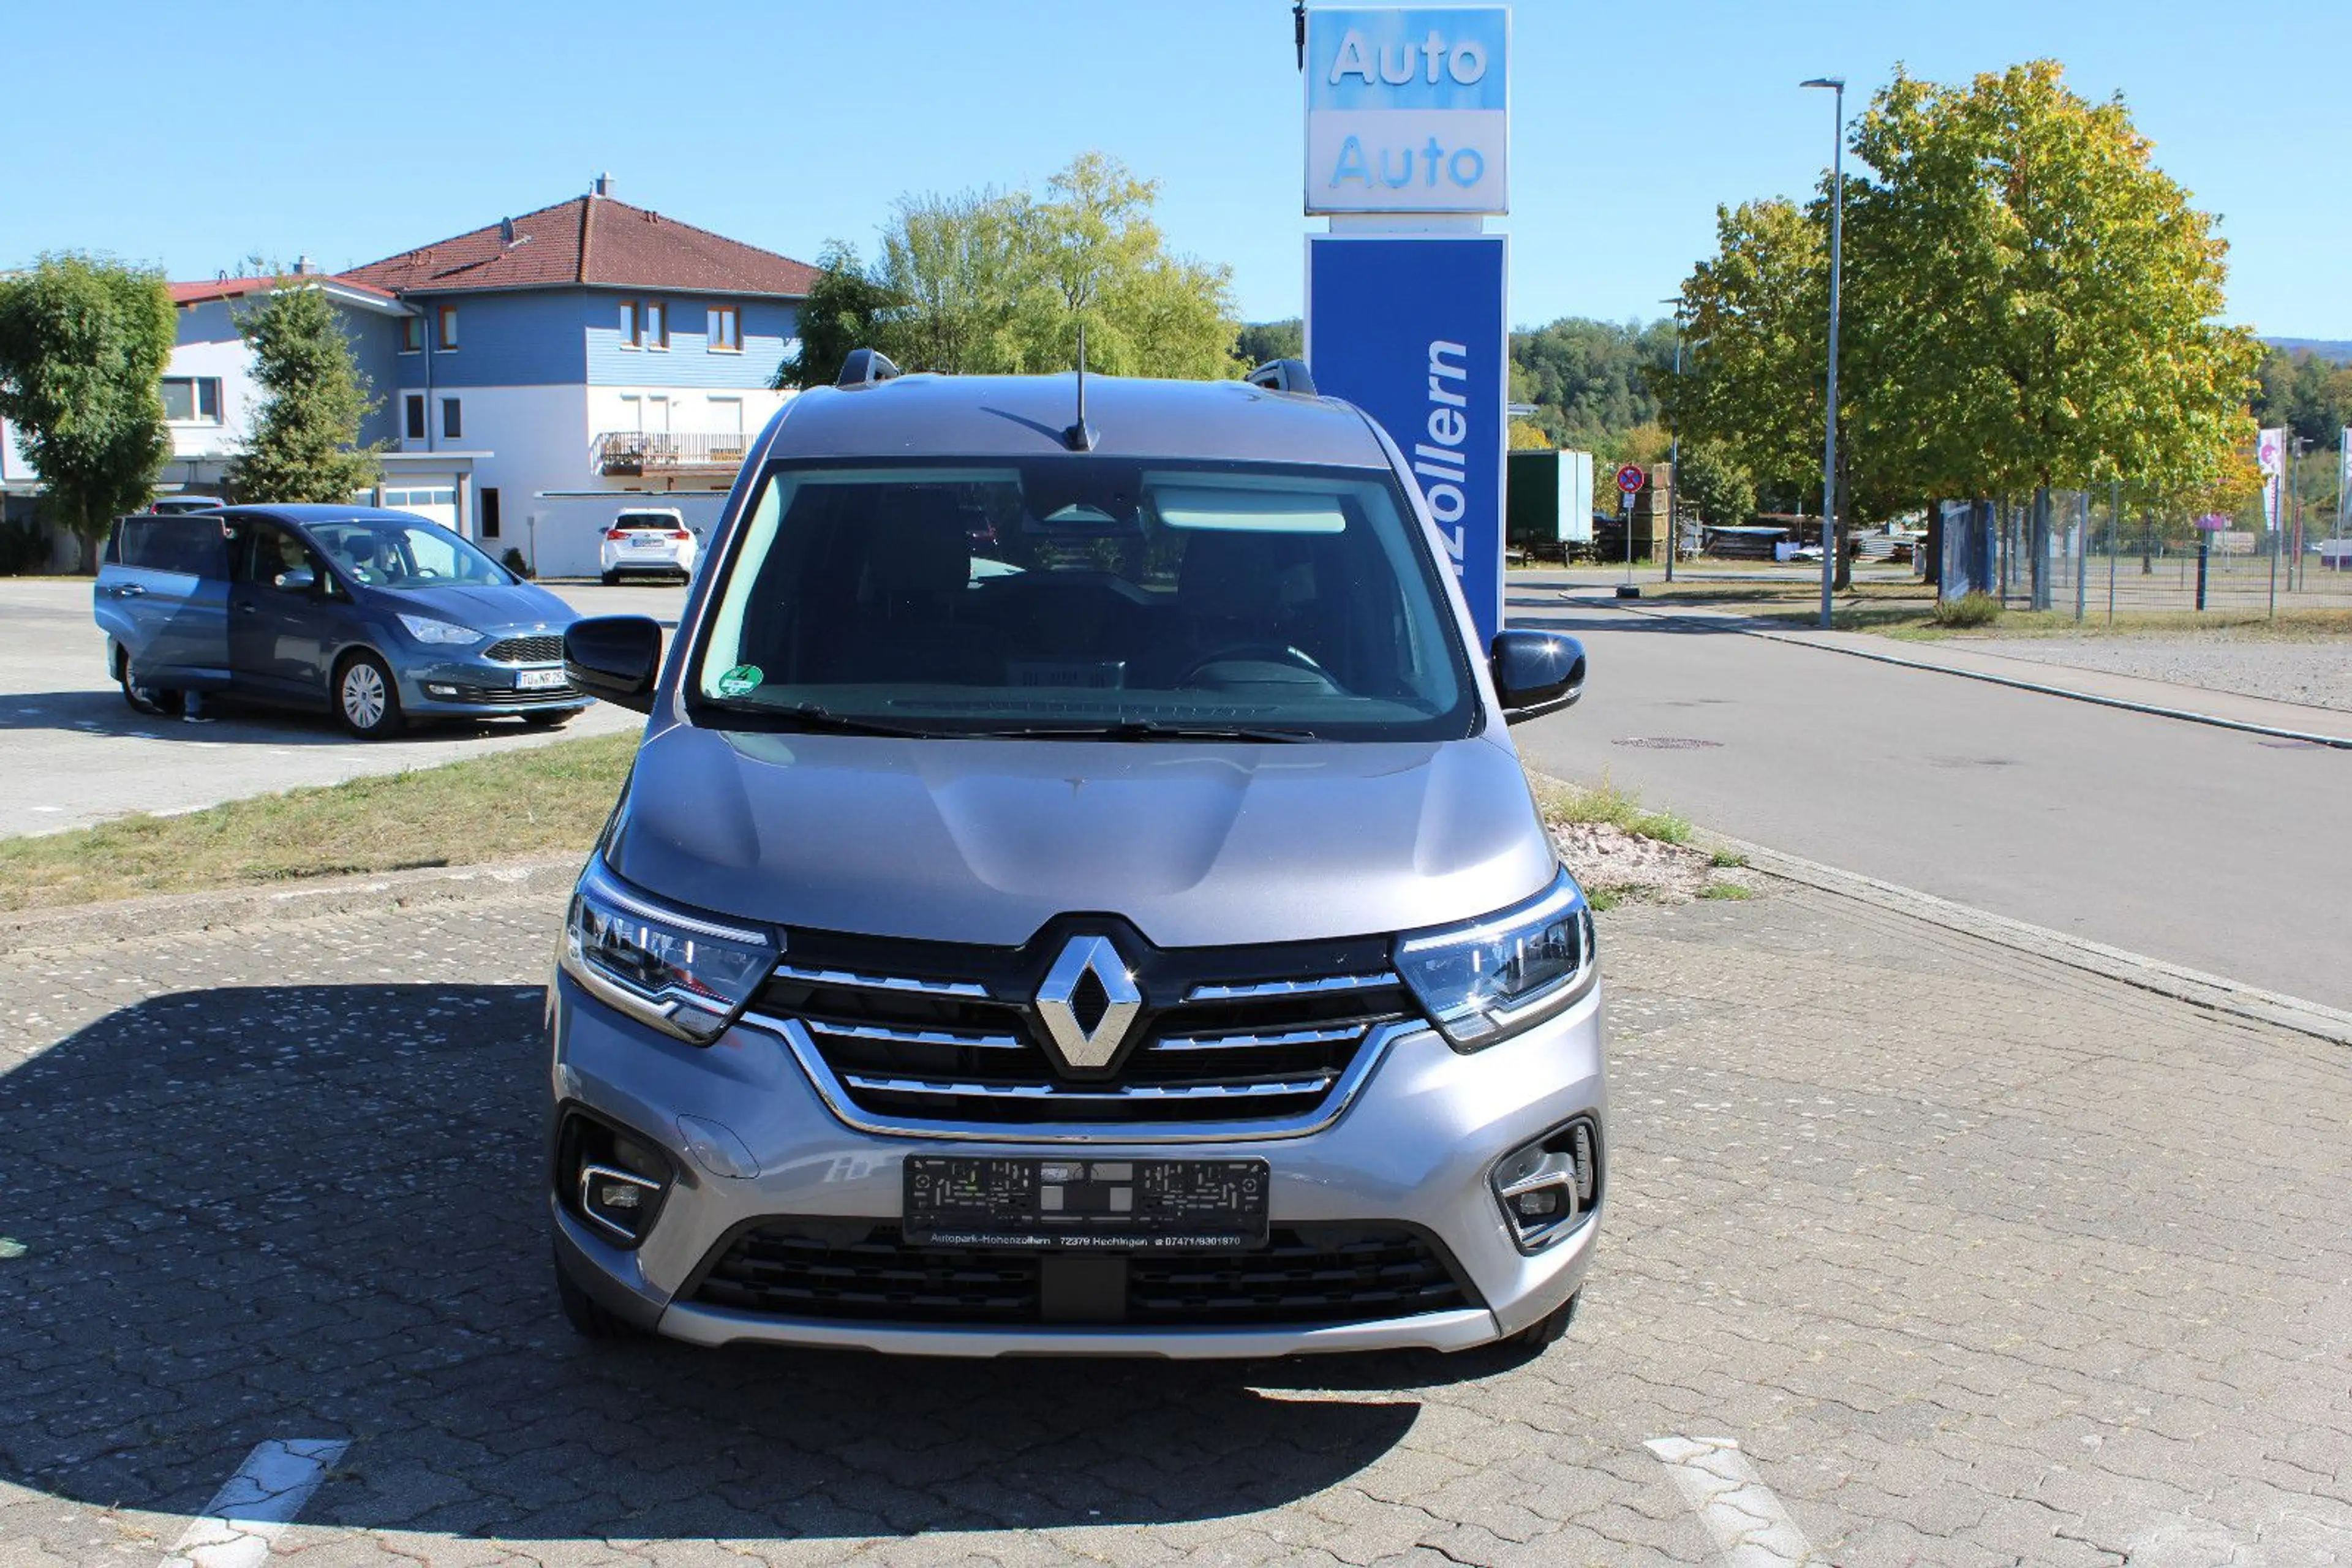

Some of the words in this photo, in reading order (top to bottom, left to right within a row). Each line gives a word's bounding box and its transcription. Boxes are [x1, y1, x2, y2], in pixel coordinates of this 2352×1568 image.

[1329, 29, 1488, 86] Auto
[1329, 135, 1485, 188] Auto
[1093, 1237, 1147, 1247] Hechingen
